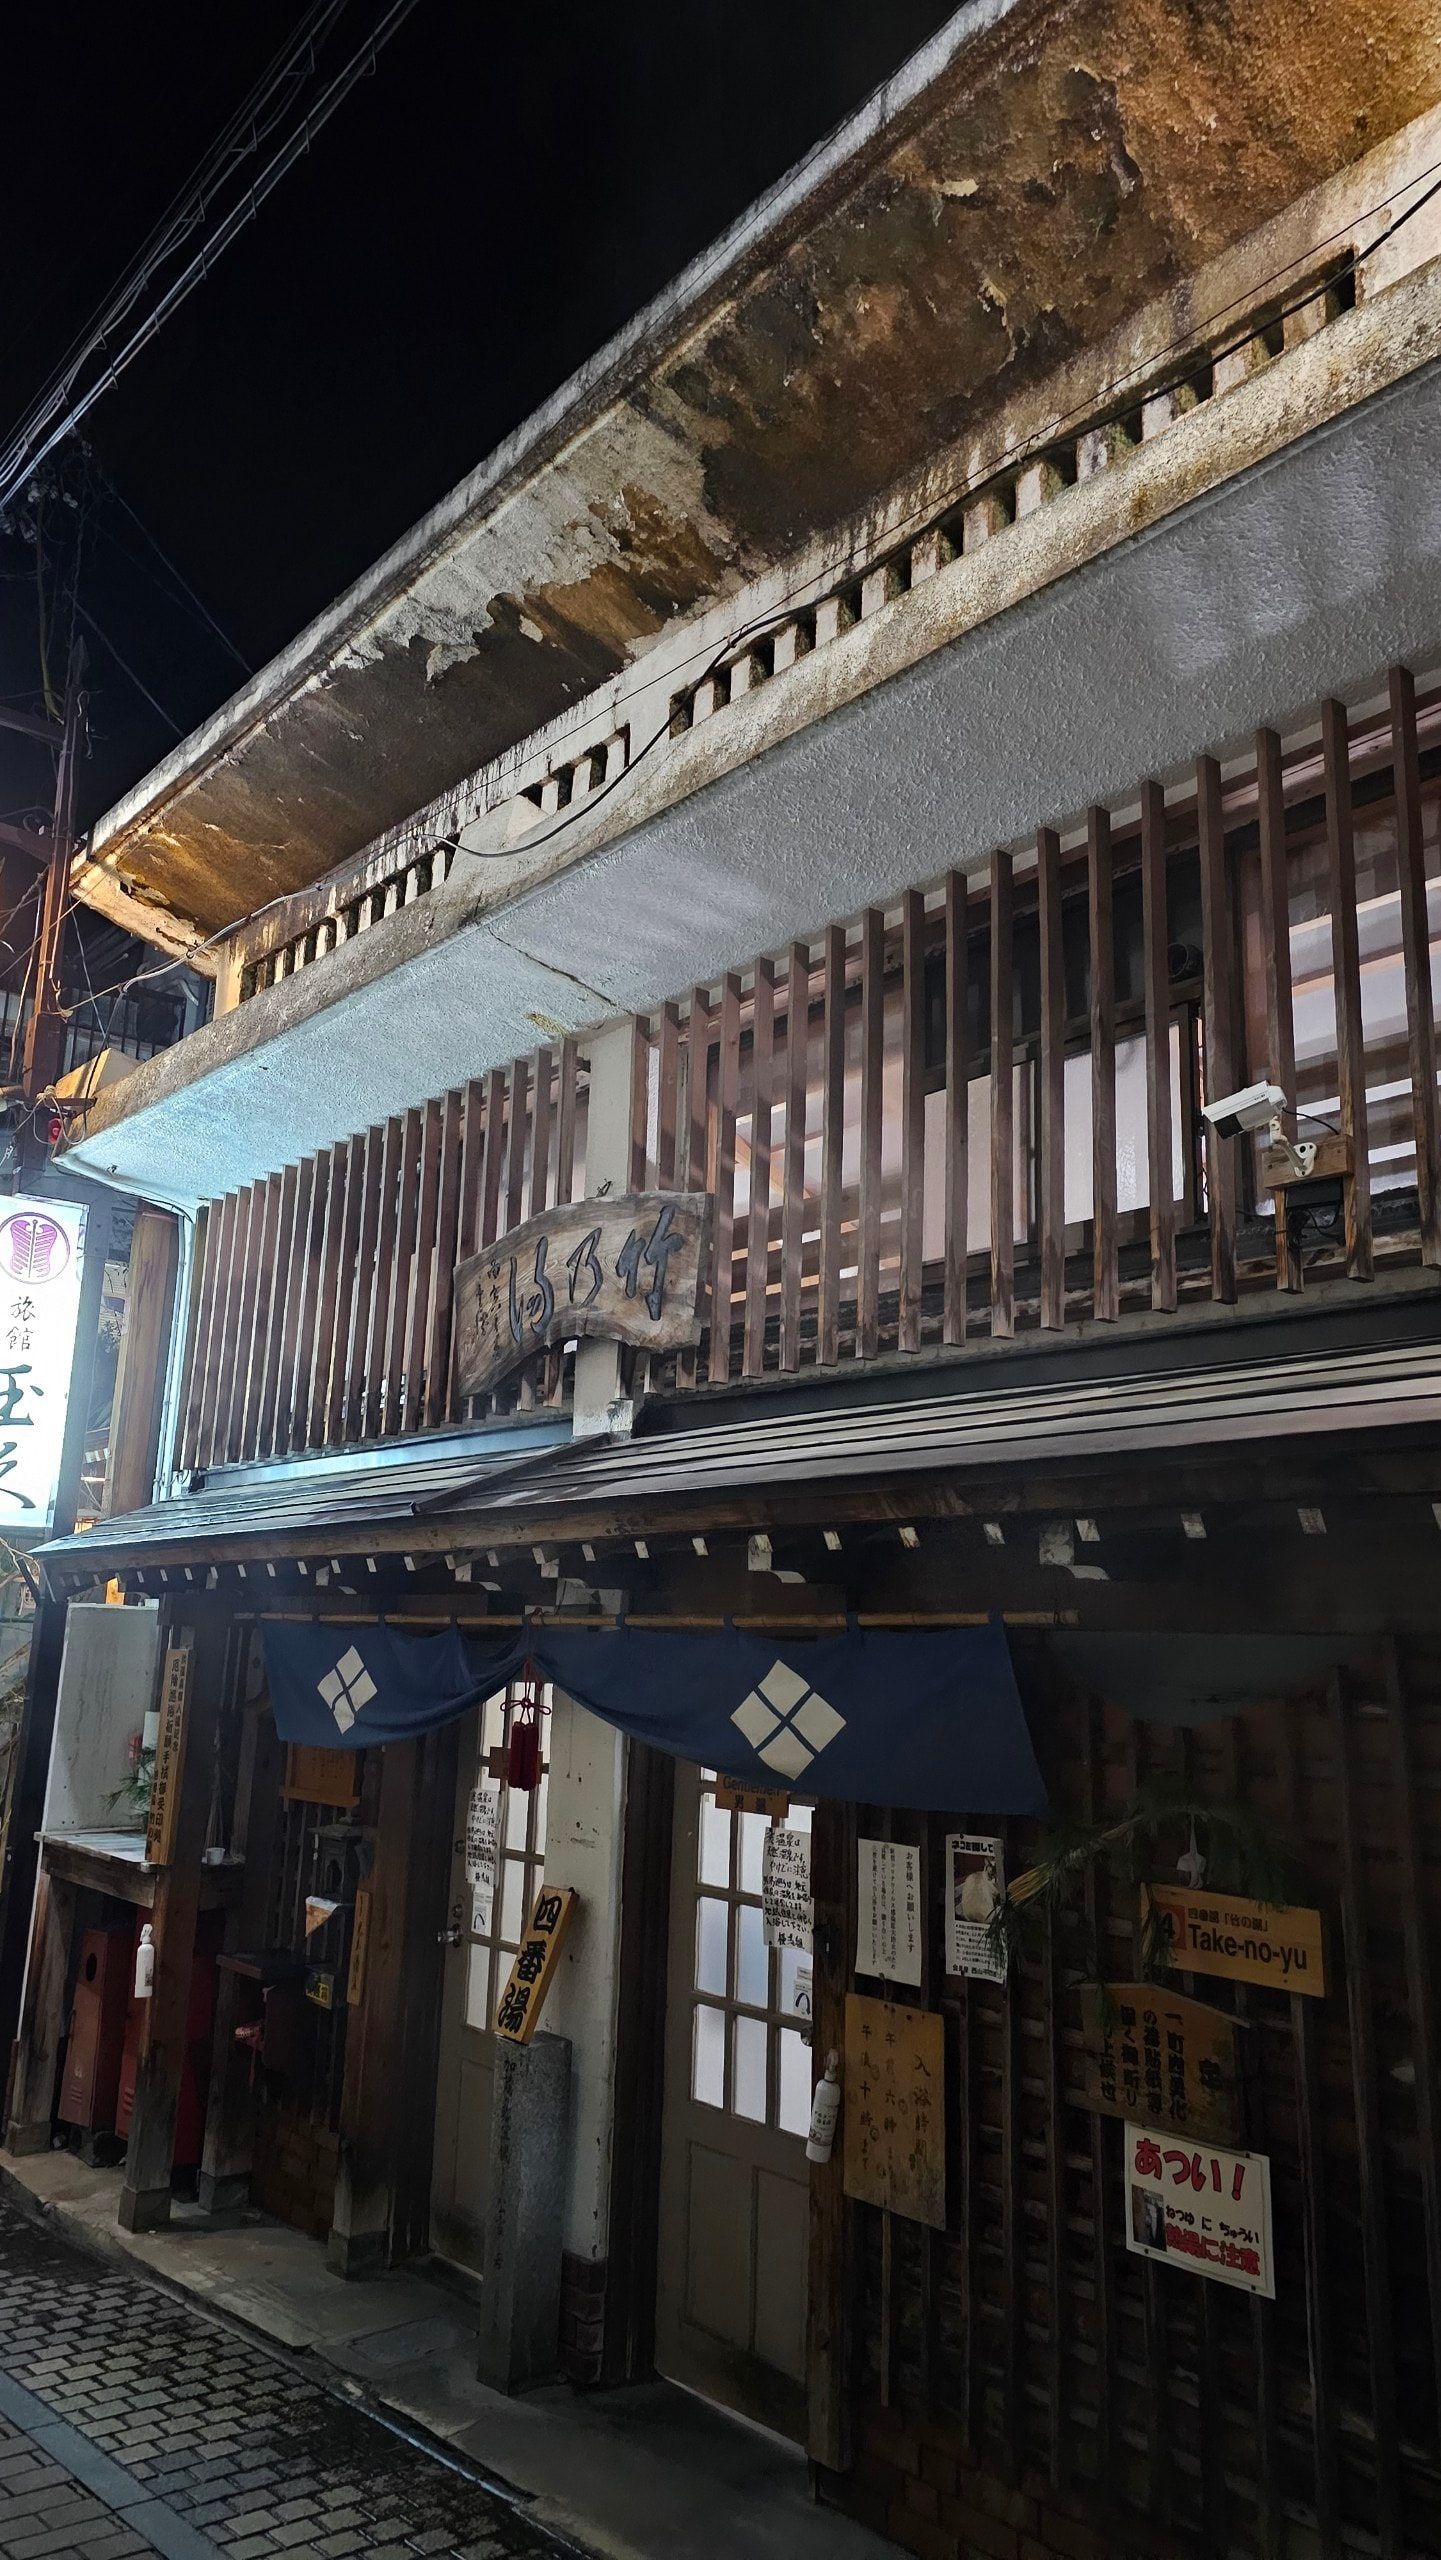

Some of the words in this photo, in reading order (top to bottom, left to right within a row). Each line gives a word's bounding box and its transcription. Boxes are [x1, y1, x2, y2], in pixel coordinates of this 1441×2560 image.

[5, 1296, 36, 1352] 旅館
[906, 1852, 914, 1953] お客様へお願いします
[498, 1894, 563, 2034] 四番湯
[1188, 1923, 1307, 1974] Take-no-yu
[912, 2055, 932, 2162] 入浴時間
[1166, 2204, 1195, 2226] ねつゆ
[1202, 2216, 1212, 2232] に
[1219, 2221, 1260, 2244] ちゅうい
[1166, 2223, 1261, 2276] 熱湯に注意
